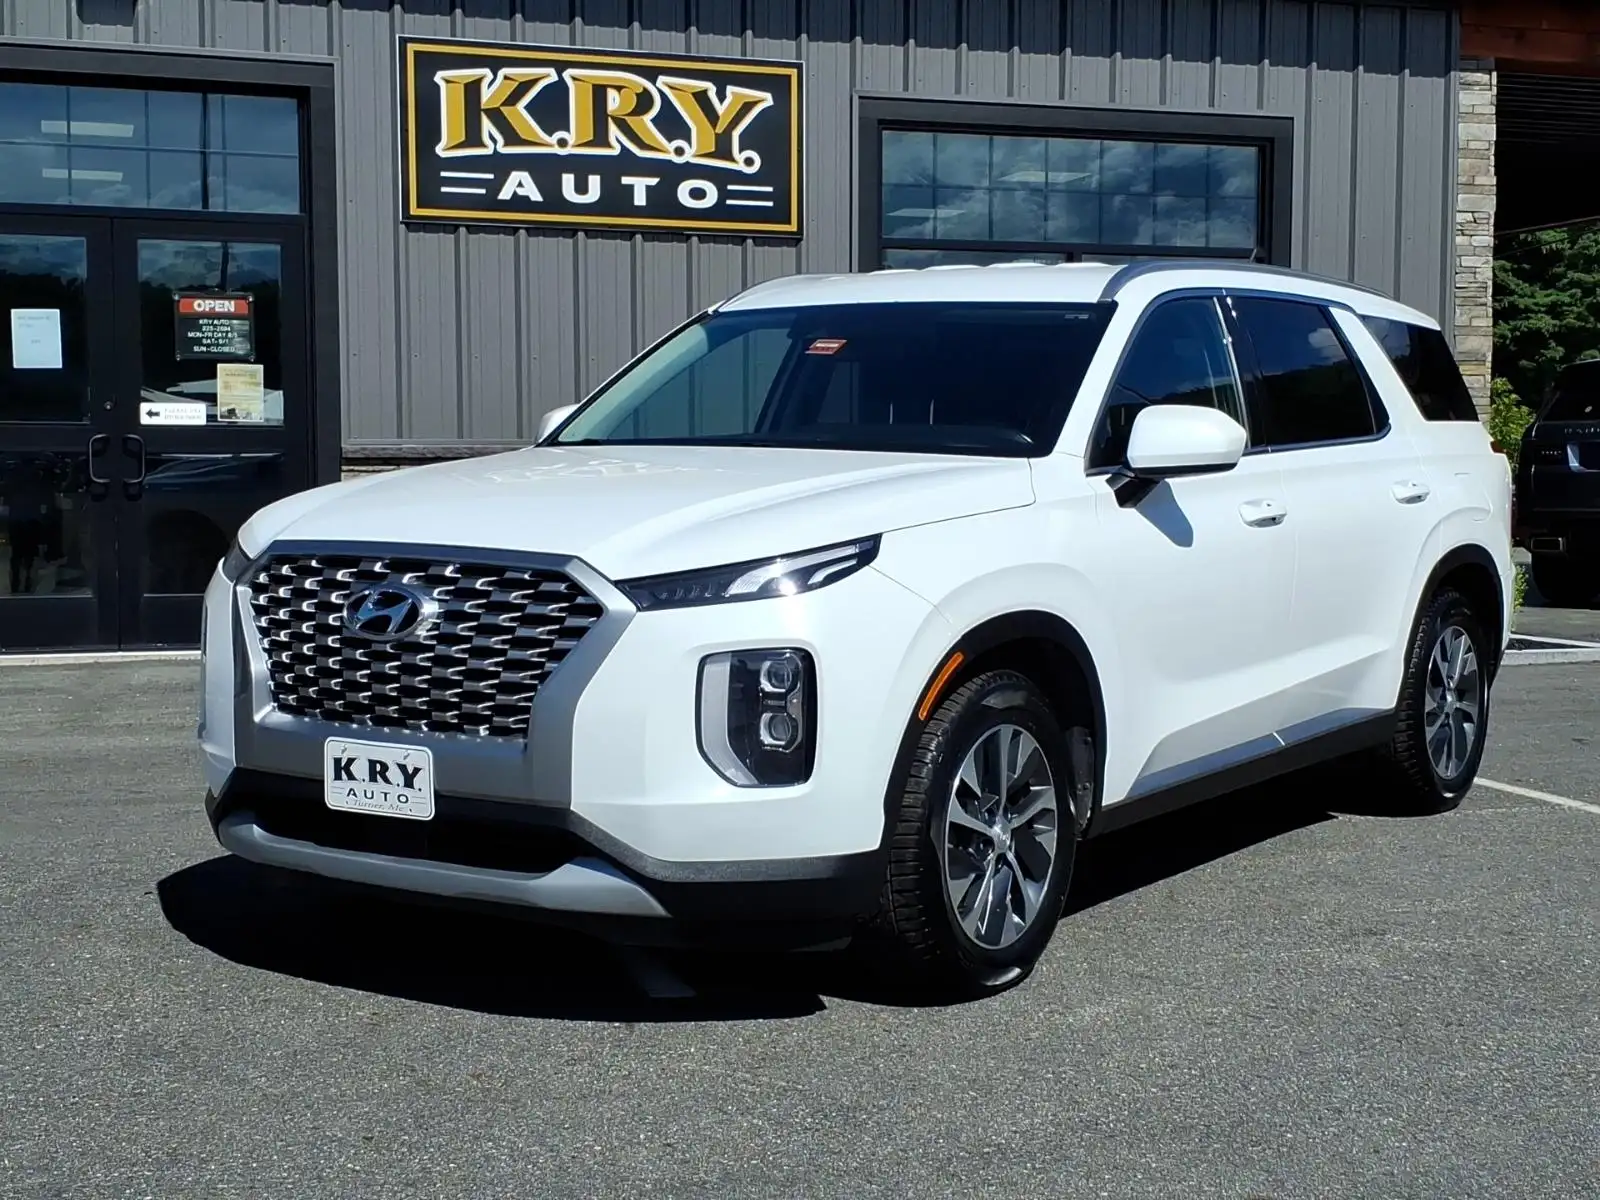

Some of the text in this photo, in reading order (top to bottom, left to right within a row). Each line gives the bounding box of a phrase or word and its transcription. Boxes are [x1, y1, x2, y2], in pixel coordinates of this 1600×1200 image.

[433, 67, 774, 174] K.R.Y.
[497, 170, 718, 209] AUTO
[193, 300, 235, 312] OPEN
[332, 756, 423, 793] K.R.Y.
[346, 787, 410, 805] AUTO
